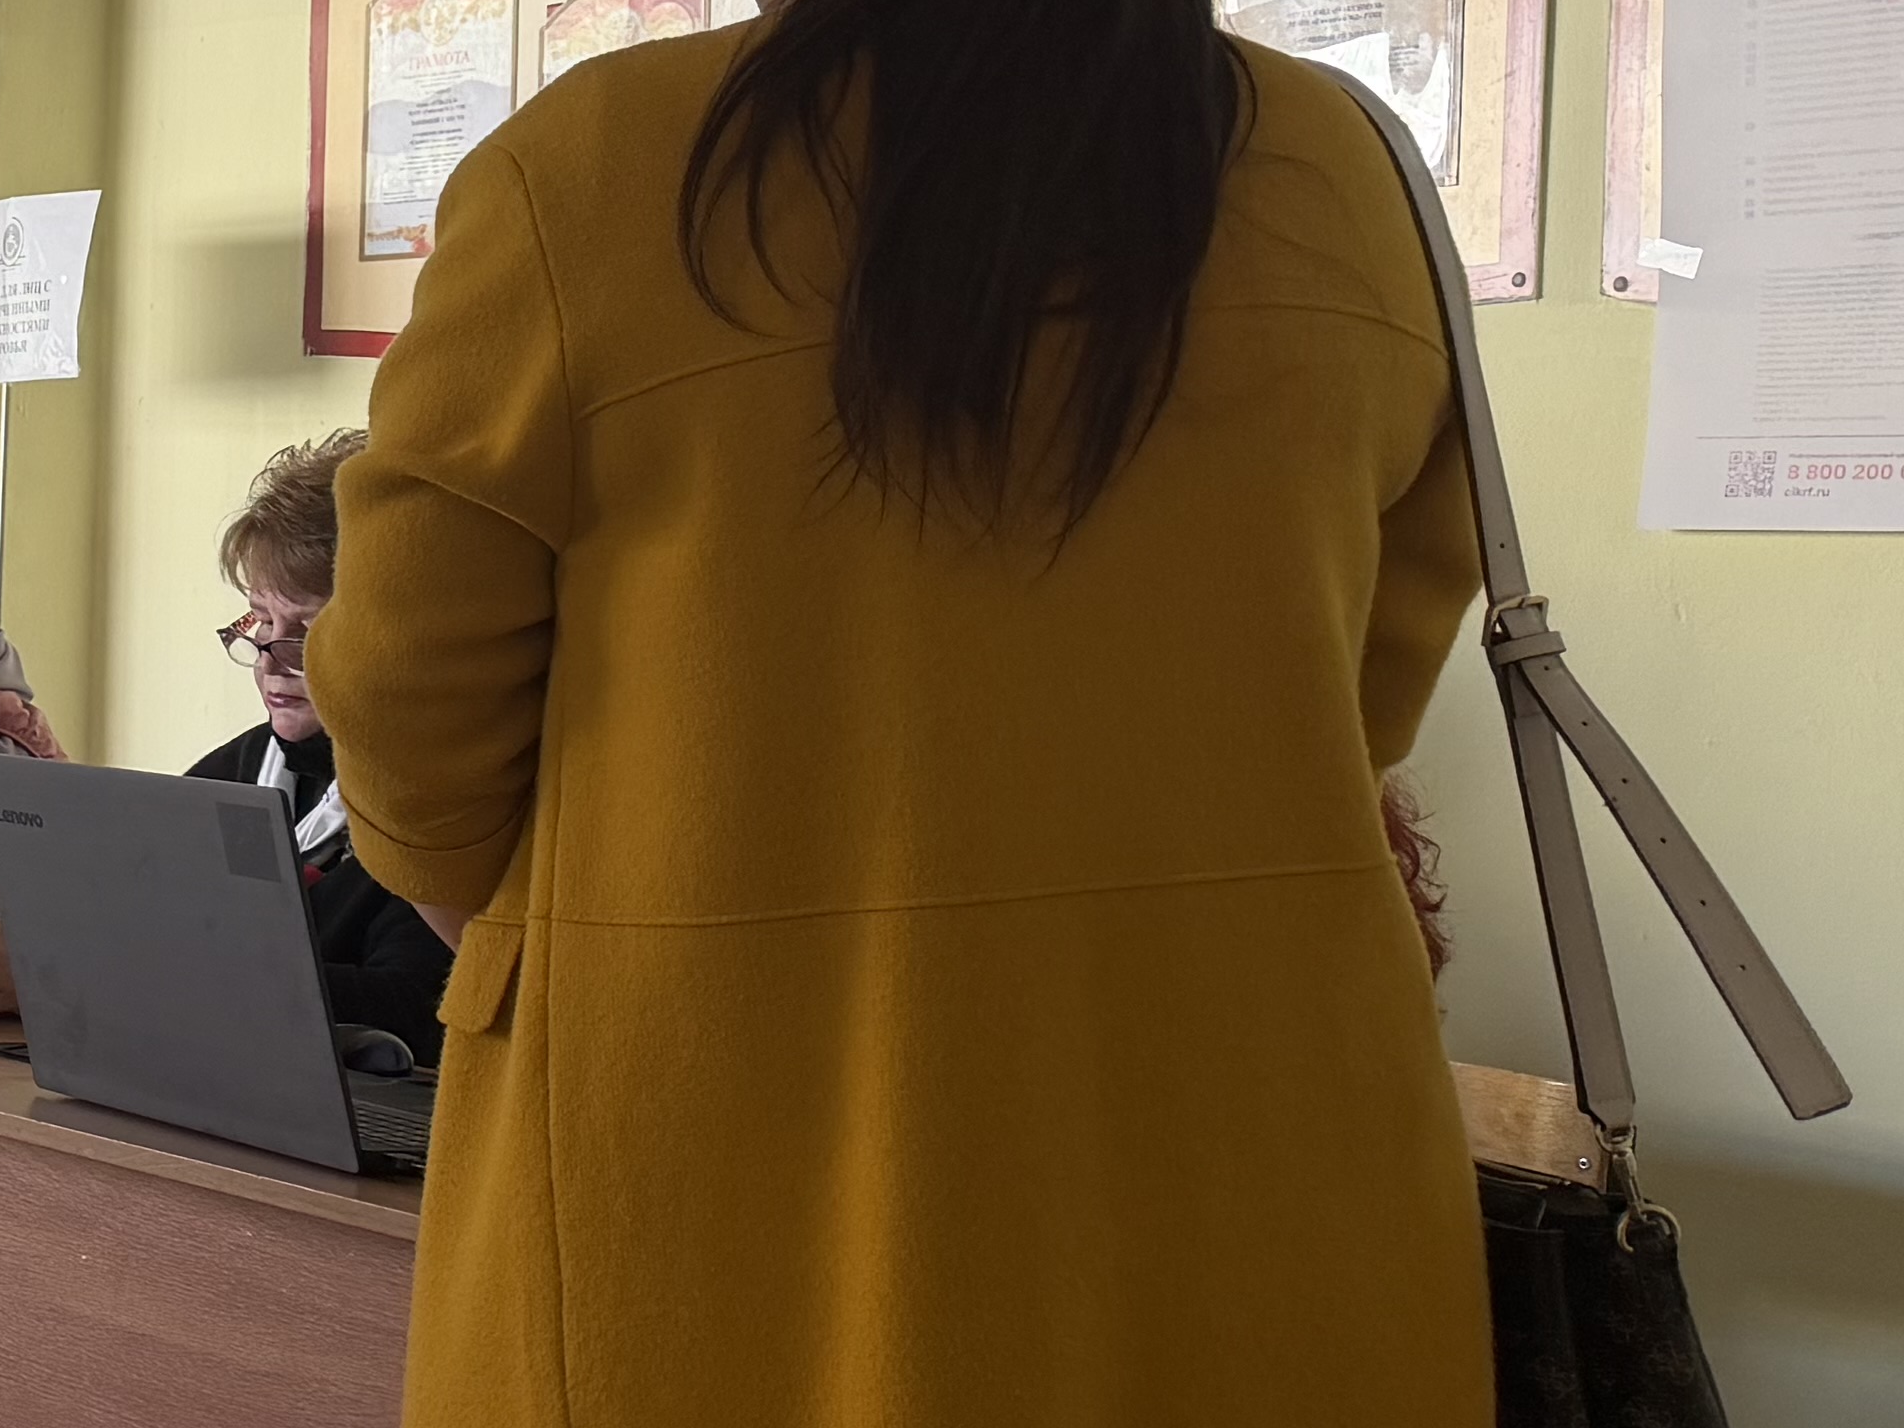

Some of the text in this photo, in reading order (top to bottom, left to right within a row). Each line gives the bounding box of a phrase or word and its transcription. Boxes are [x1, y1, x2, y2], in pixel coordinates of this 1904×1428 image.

[409, 51, 470, 70] ГРАМОТА
[44, 279, 53, 292] С
[1788, 465, 1799, 480] 8
[1806, 464, 1847, 480] 800
[1852, 464, 1894, 480] 200
